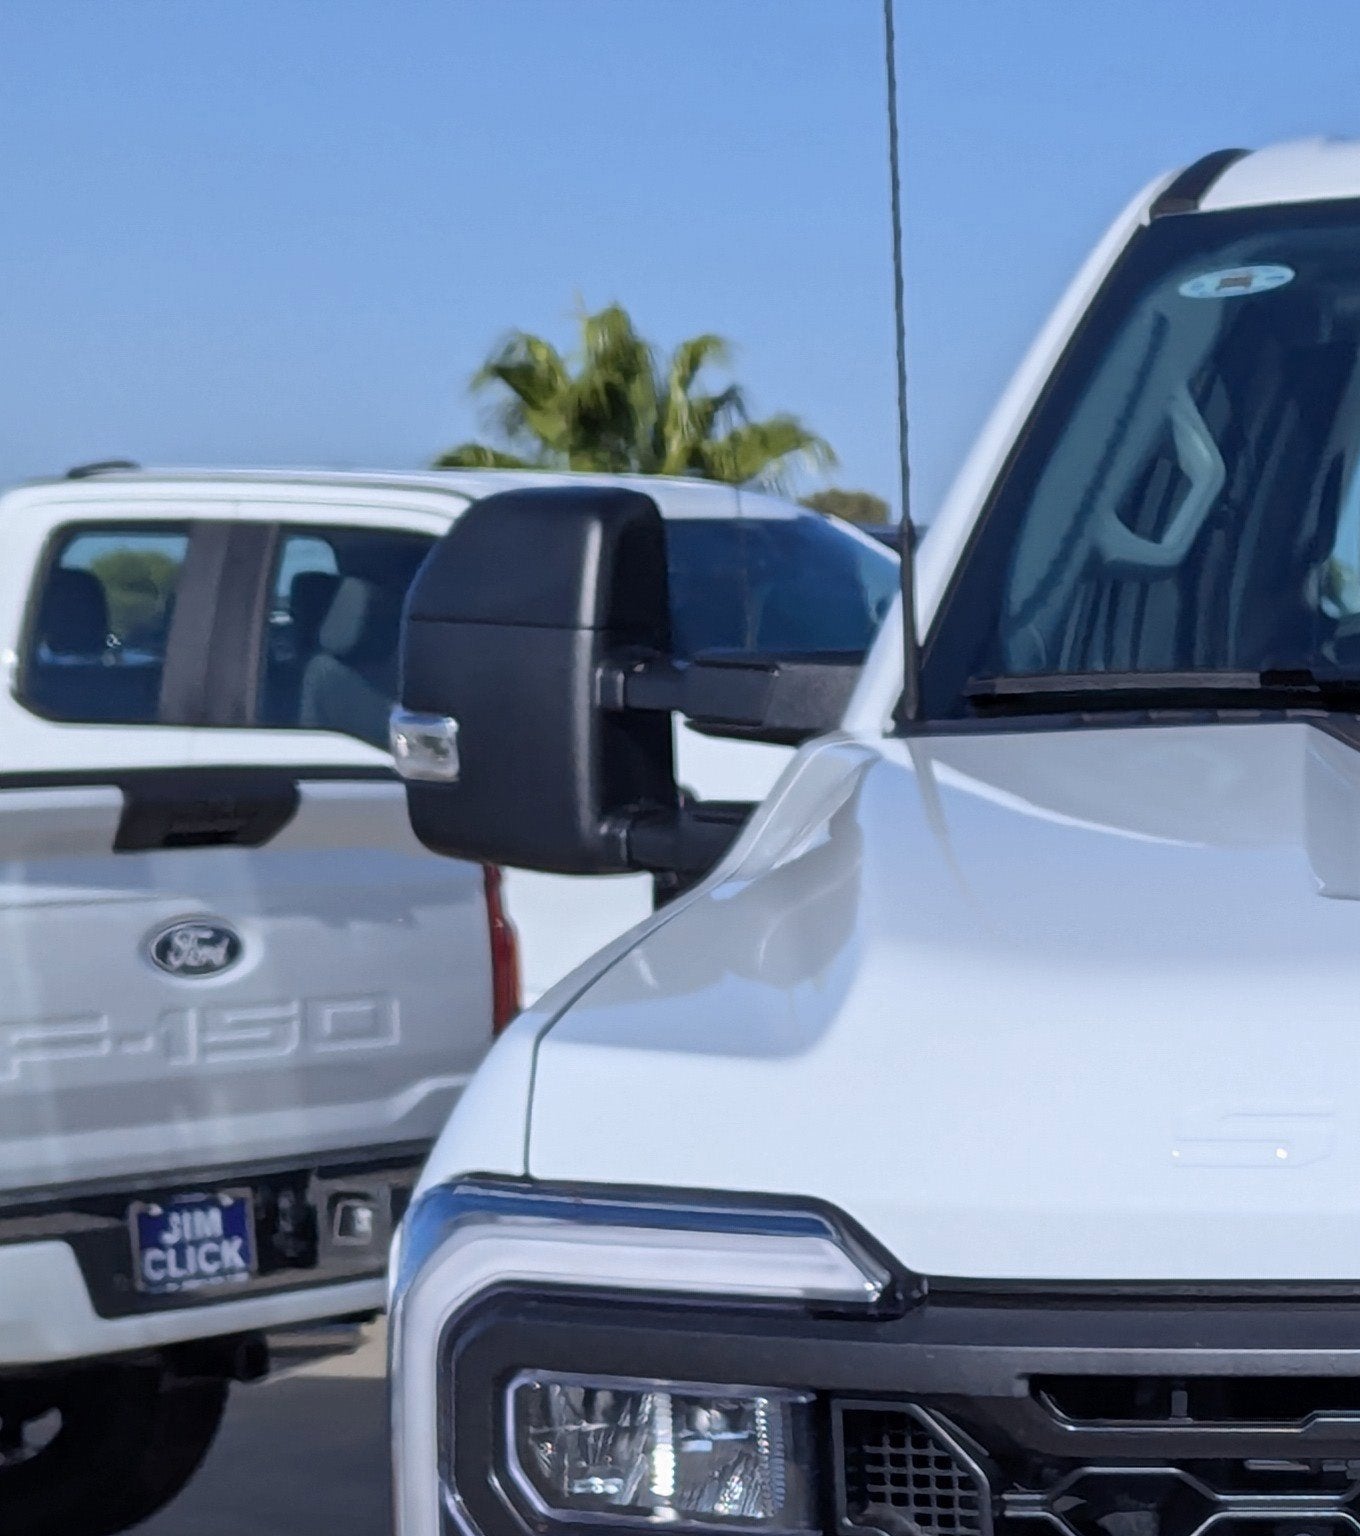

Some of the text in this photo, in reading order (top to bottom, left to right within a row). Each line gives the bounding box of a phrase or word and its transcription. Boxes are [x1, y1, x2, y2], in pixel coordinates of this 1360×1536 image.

[164, 926, 231, 972] Ford
[0, 996, 401, 1081] F-150
[160, 1206, 224, 1246] JIM
[143, 1235, 247, 1282] CLICK
